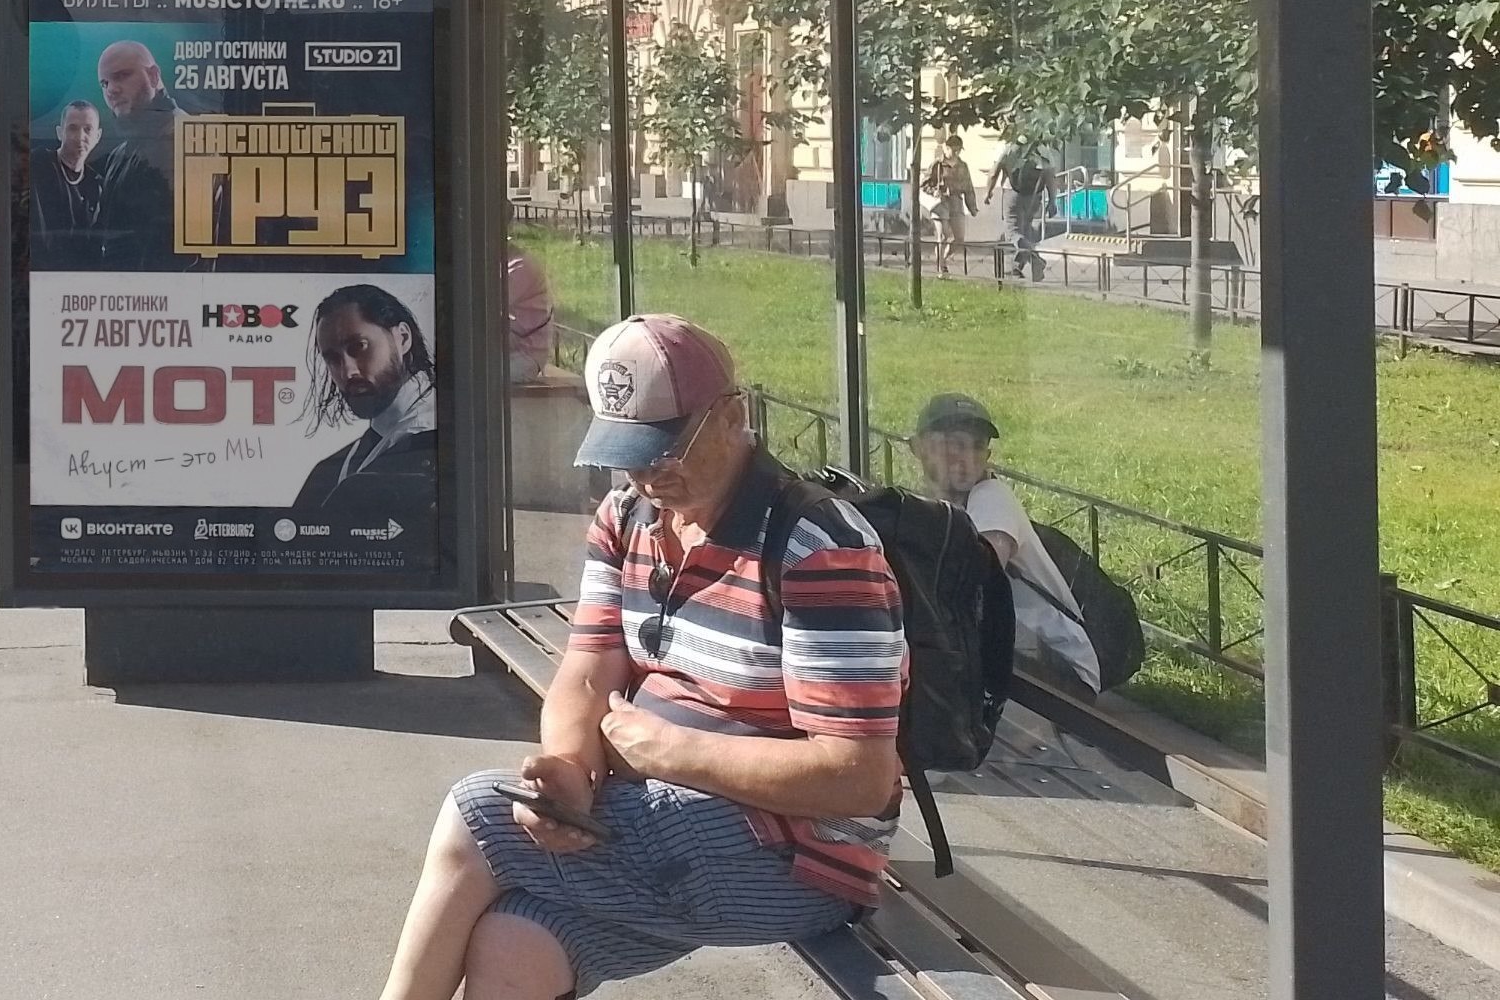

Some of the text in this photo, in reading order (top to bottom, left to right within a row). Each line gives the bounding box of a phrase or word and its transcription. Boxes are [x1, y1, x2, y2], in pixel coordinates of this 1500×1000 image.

[174, 41, 287, 60] ДВОР ГОСТИНКИ
[313, 49, 393, 64] STUDIO 21
[174, 65, 289, 90] 25 АВГУСТА
[184, 124, 396, 154] КАСПИЙСКИЙ
[184, 156, 396, 245] ГРУЗ
[61, 295, 168, 313] ДВОР ГОСТИНКИ
[61, 319, 192, 347] 27 АВГУСТА
[229, 334, 273, 343] РАДИО
[62, 365, 296, 425] МОТ
[68, 450, 146, 488] Август
[181, 452, 216, 467] это
[226, 437, 263, 461] МЫ
[300, 526, 330, 536] KUDAGO
